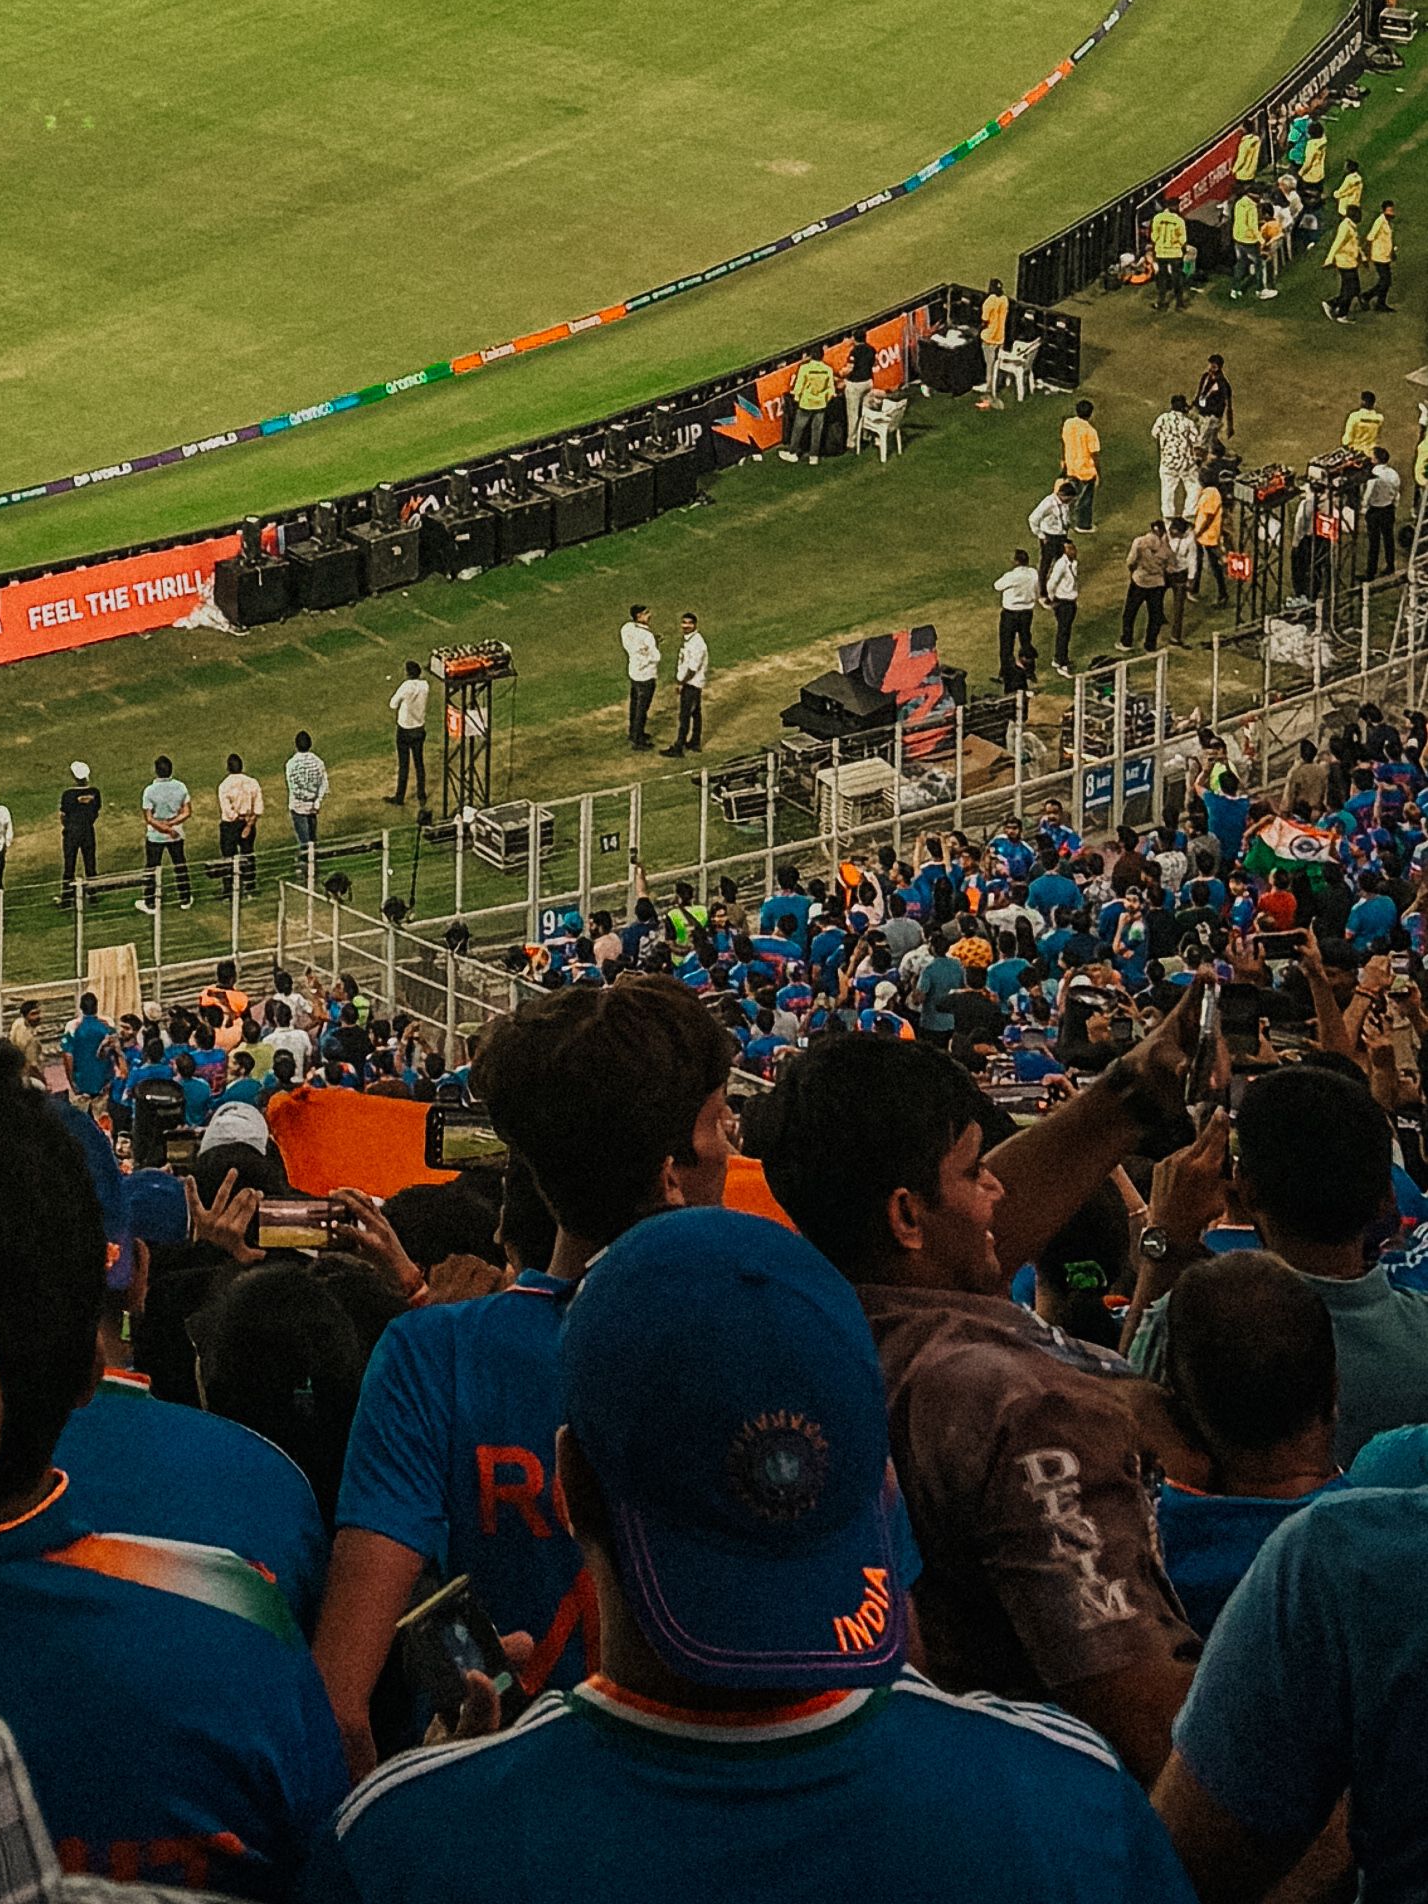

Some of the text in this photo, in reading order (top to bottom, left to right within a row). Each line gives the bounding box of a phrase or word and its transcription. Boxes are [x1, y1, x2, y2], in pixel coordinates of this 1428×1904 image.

[28, 571, 205, 631] FEEL THE THRILL
[1141, 758, 1152, 780] 7
[1085, 773, 1095, 797] 8
[543, 909, 556, 935] 9
[832, 1567, 889, 1653] INDIA
